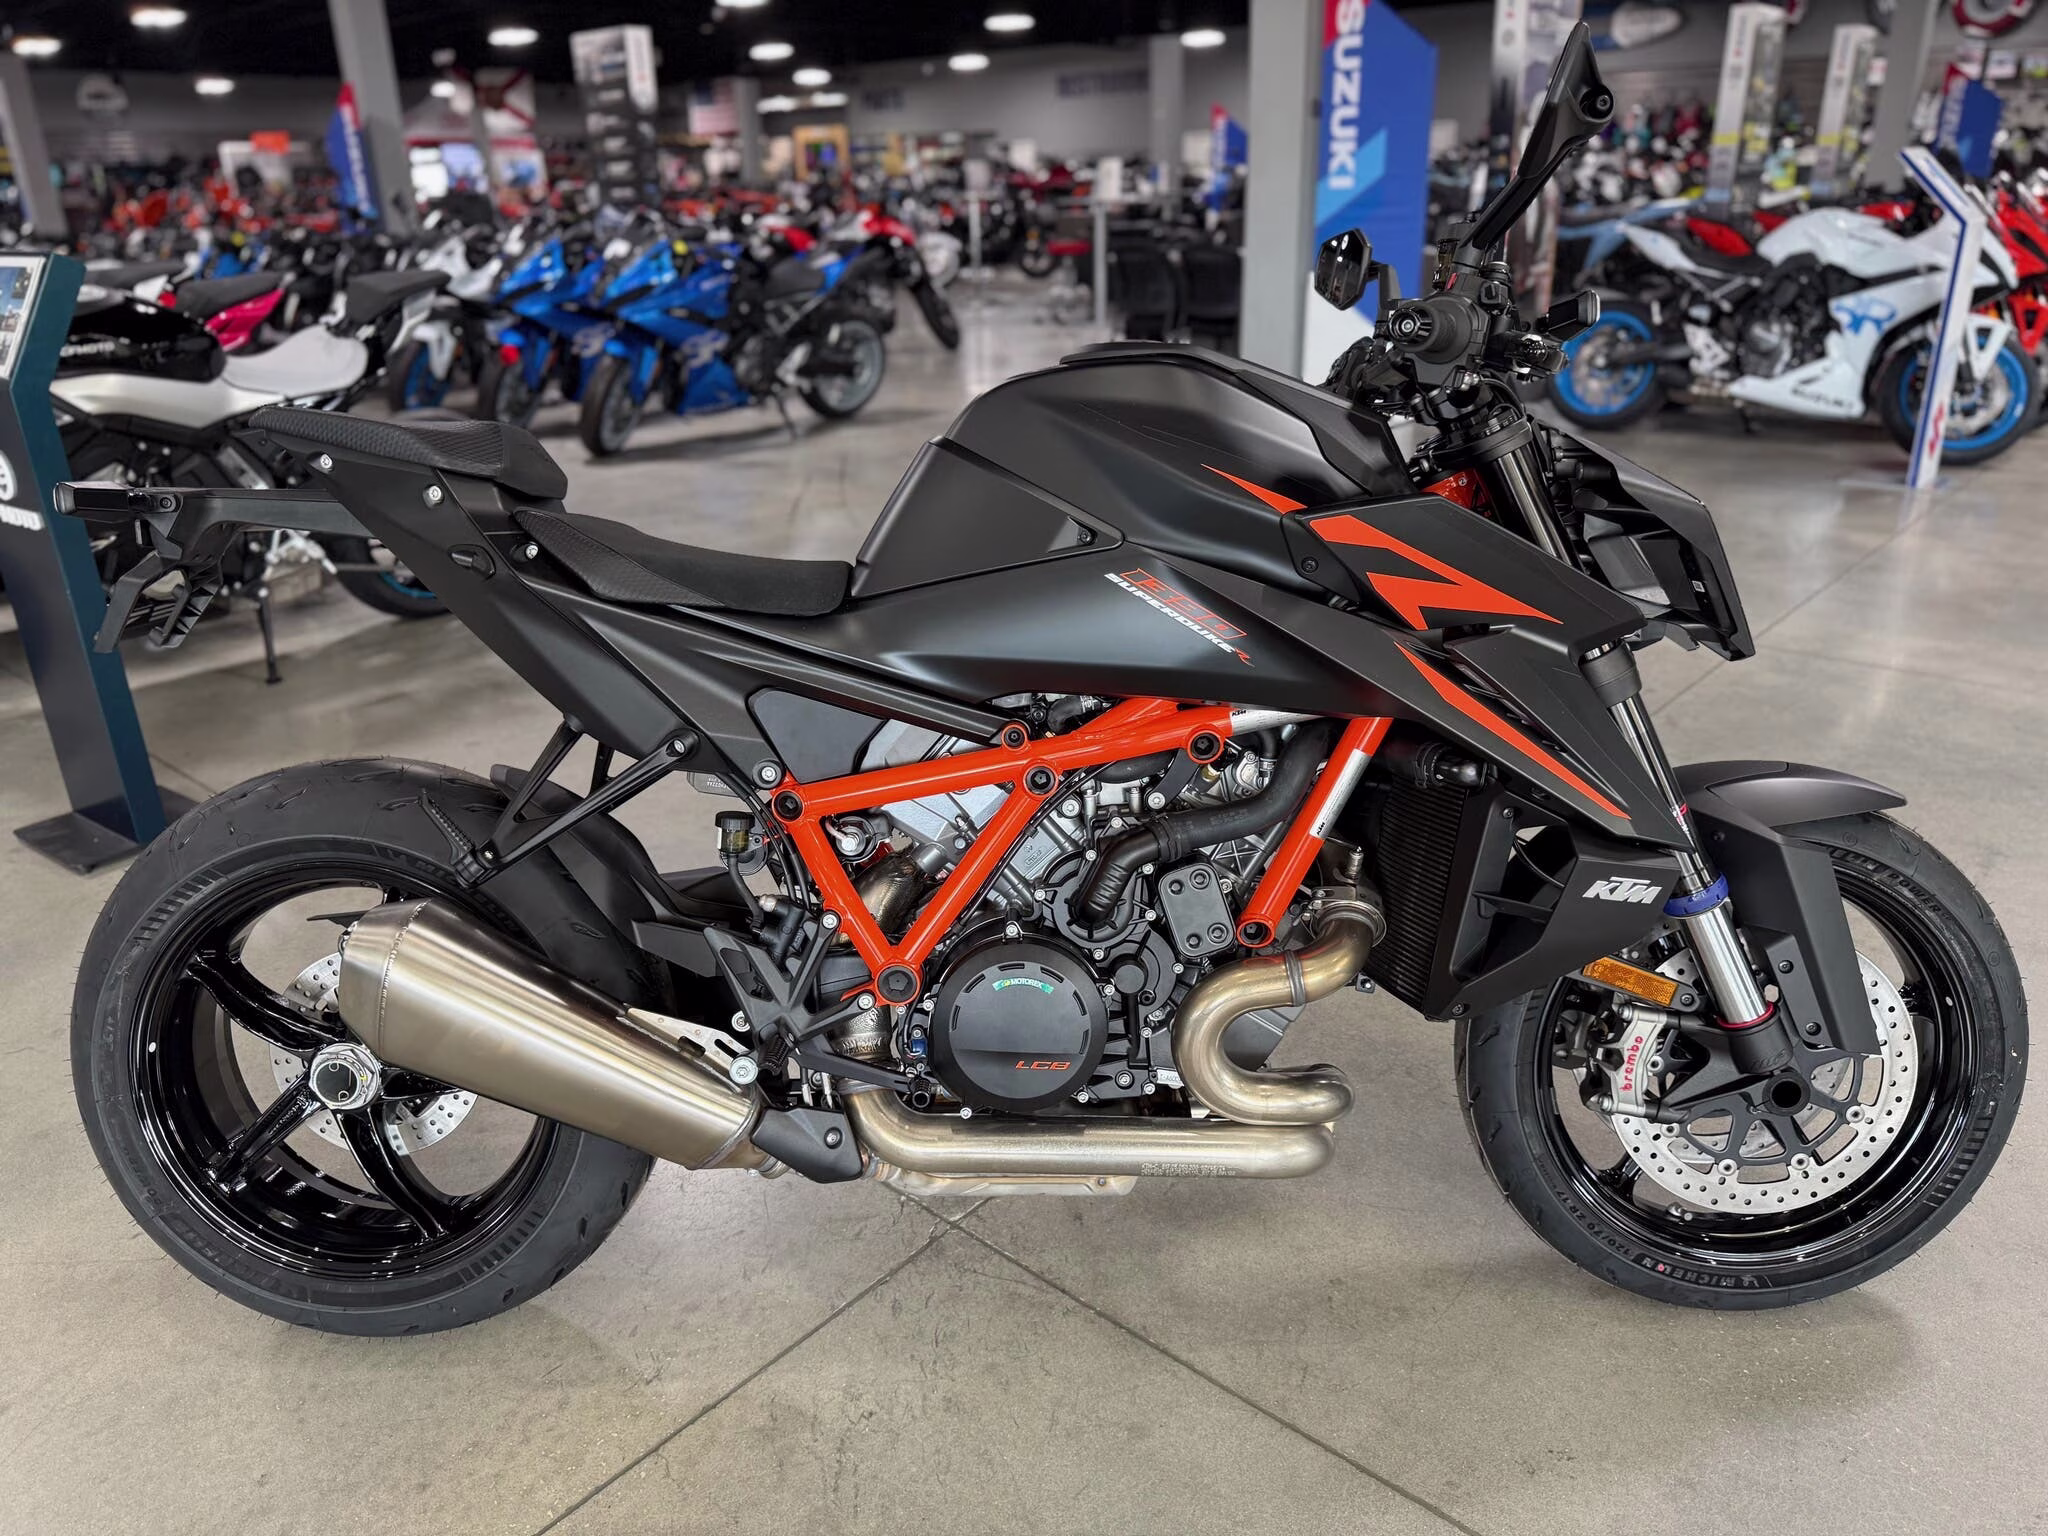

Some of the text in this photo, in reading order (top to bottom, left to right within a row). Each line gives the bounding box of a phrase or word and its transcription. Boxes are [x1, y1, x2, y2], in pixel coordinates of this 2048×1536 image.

[1327, 0, 1366, 190] SUZUKI
[1582, 876, 1663, 904] KTM
[1010, 977, 1043, 989] MOTOREX
[1015, 1060, 1071, 1071] LC8
[1620, 1035, 1644, 1092] brembo
[1586, 1222, 1630, 1256] 120/70
[1641, 1257, 1737, 1288] MICHELN
